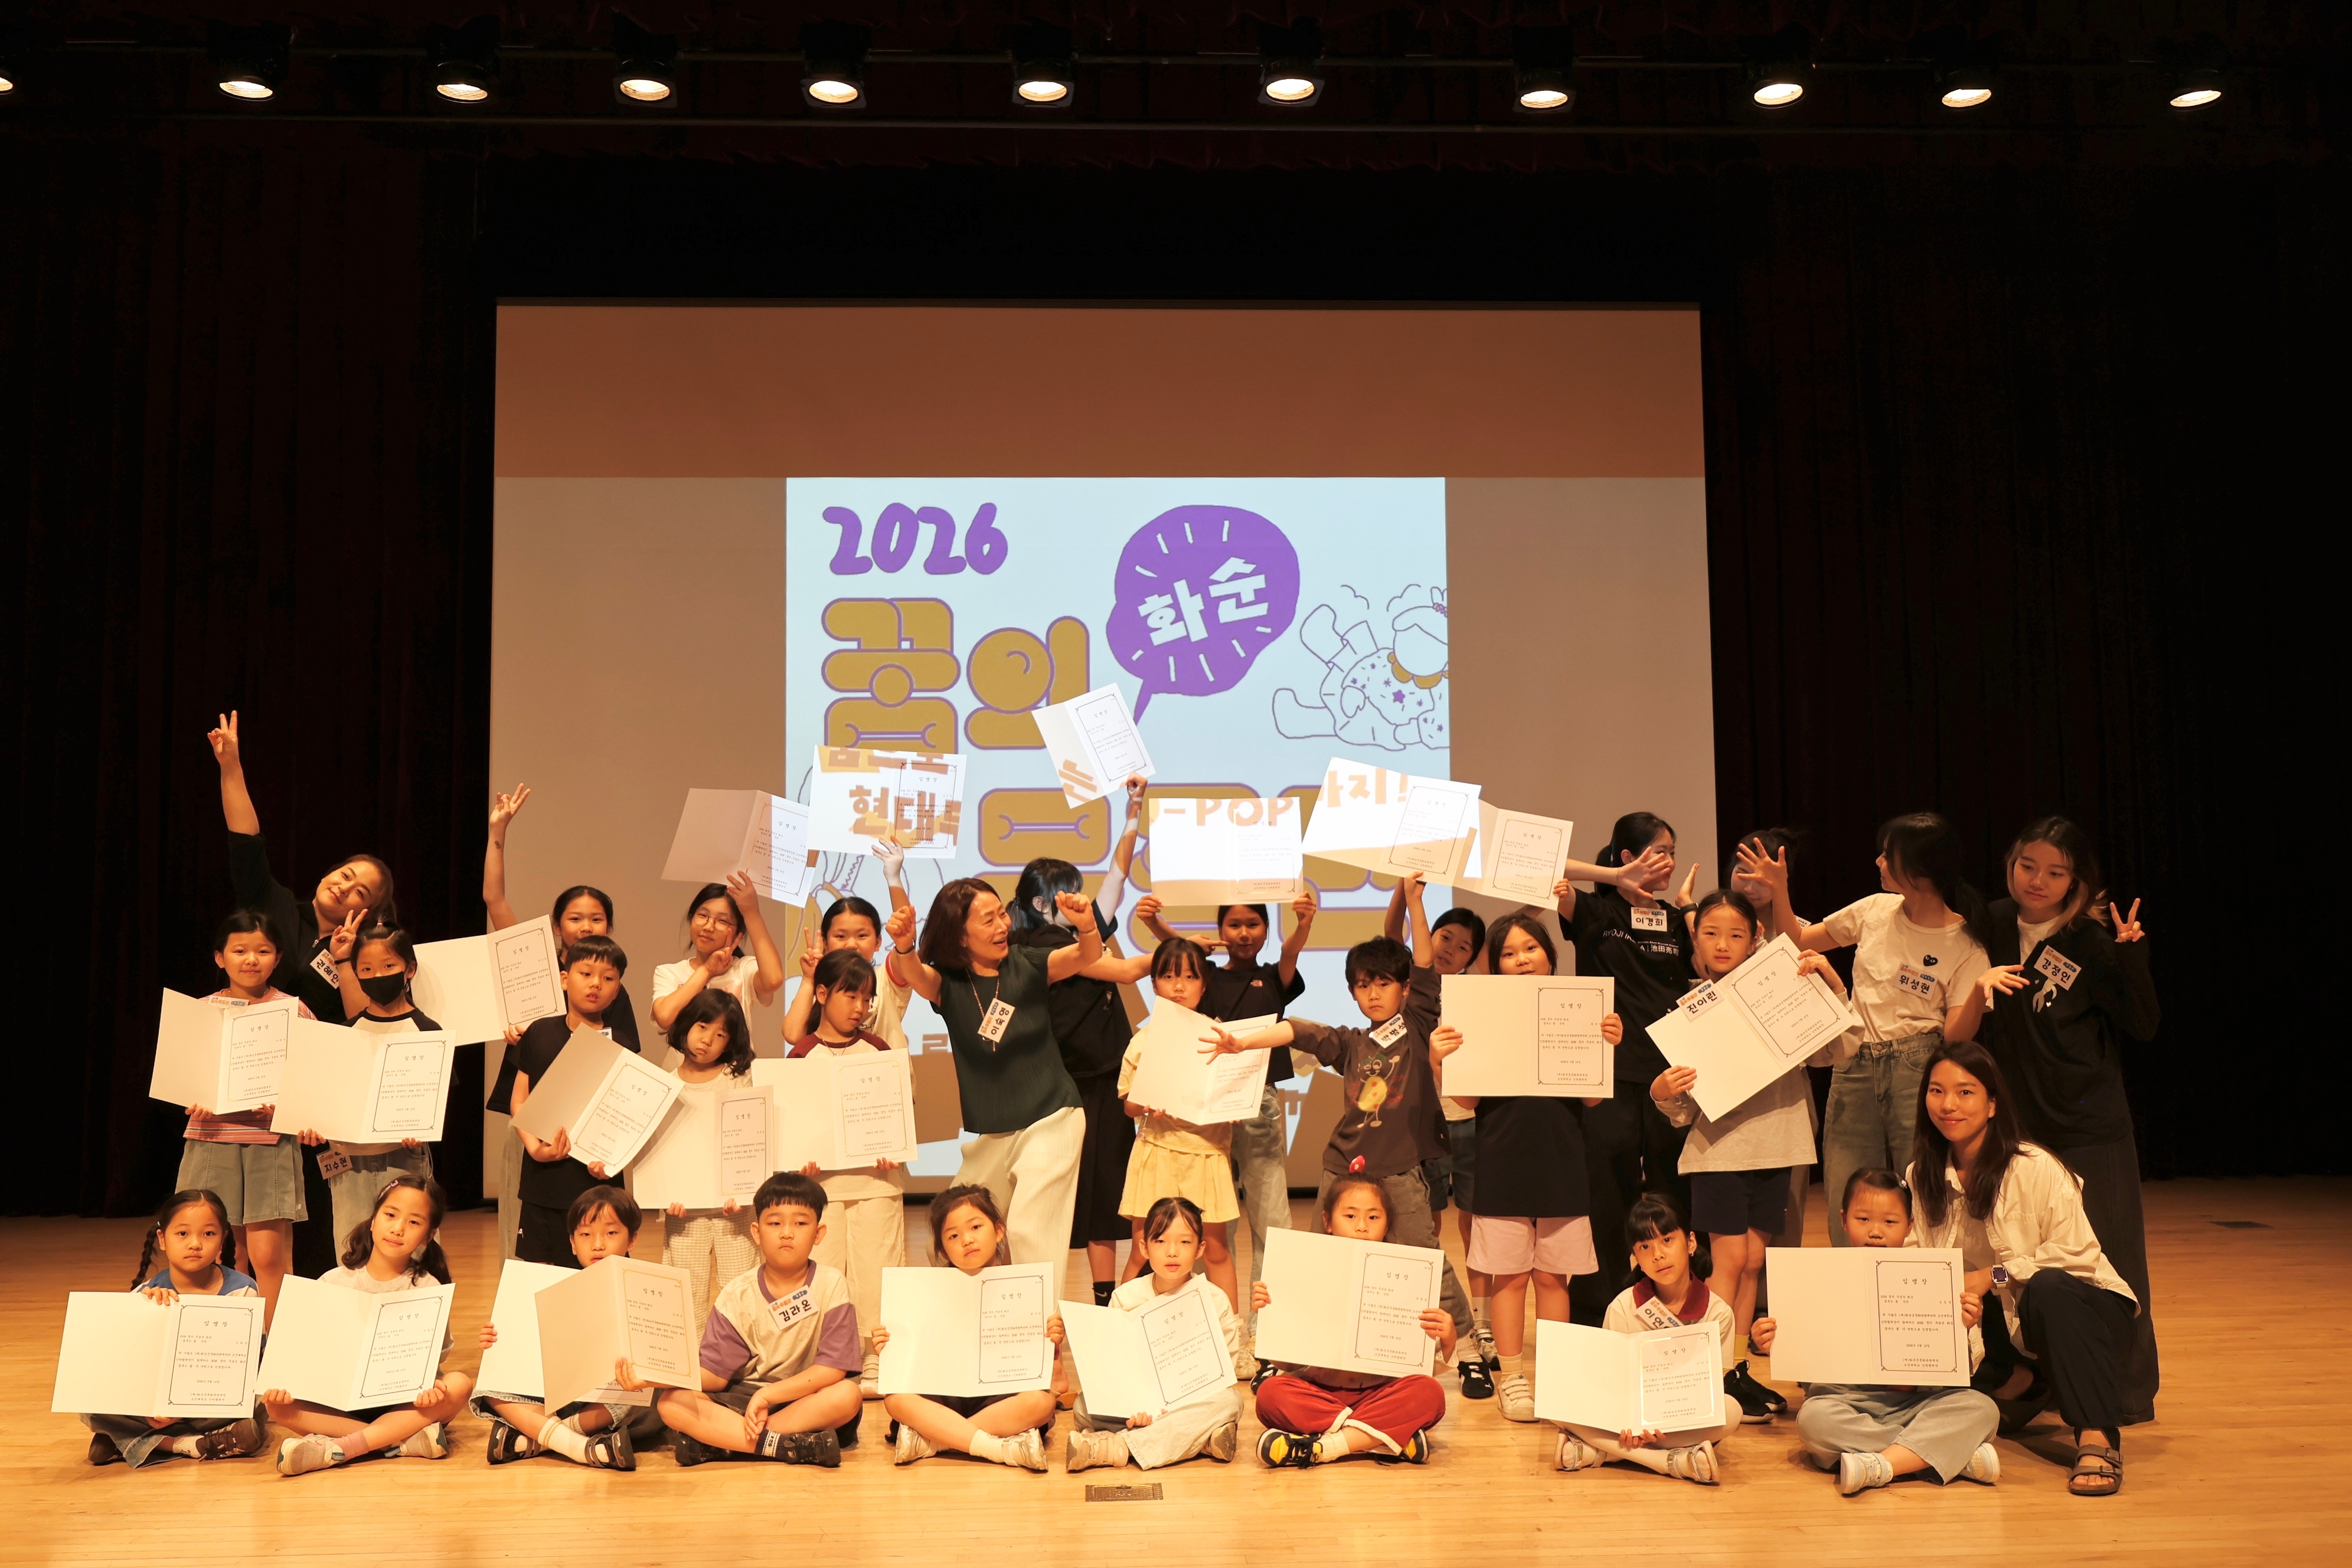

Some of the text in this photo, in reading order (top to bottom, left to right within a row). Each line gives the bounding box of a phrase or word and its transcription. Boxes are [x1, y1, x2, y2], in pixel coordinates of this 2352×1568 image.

[822, 502, 1008, 576] 2026
[1138, 556, 1269, 646] 화순
[1636, 917, 1662, 926] 이경희
[1651, 944, 1678, 956] 池田亮司
[2041, 958, 2071, 984] 강정인
[1899, 975, 1930, 995] 위성현
[1687, 991, 1717, 1014] 진이린
[991, 1007, 1010, 1035] 이숙영
[324, 1157, 347, 1173] 지수현
[779, 1299, 812, 1322] 김라온
[1645, 1308, 1670, 1328] 이연
